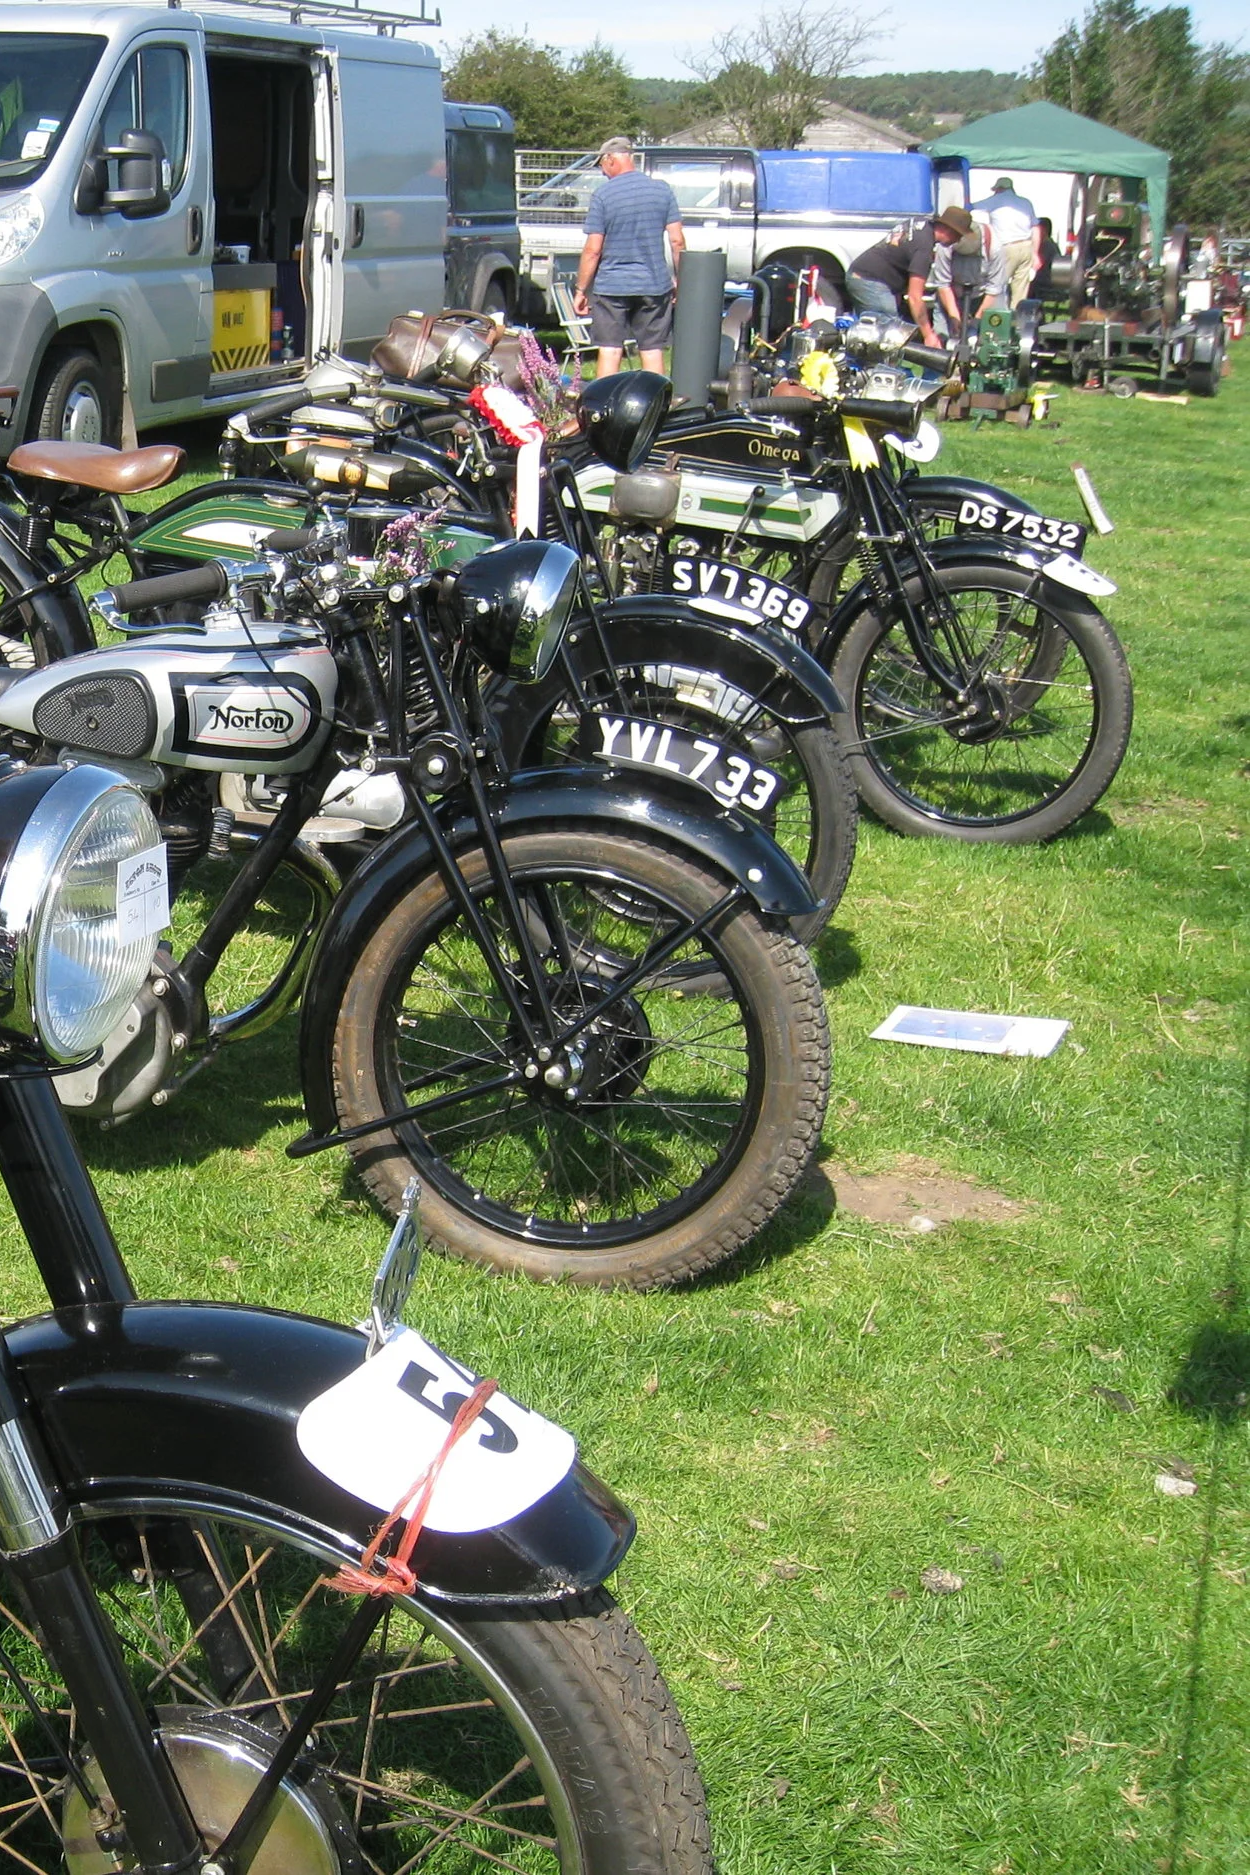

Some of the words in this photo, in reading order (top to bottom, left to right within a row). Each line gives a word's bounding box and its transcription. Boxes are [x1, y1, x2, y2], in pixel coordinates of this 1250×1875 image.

[748, 438, 800, 461] Omega
[958, 500, 999, 529] DS
[1001, 510, 1080, 549] 7532
[208, 704, 294, 734] Norton
